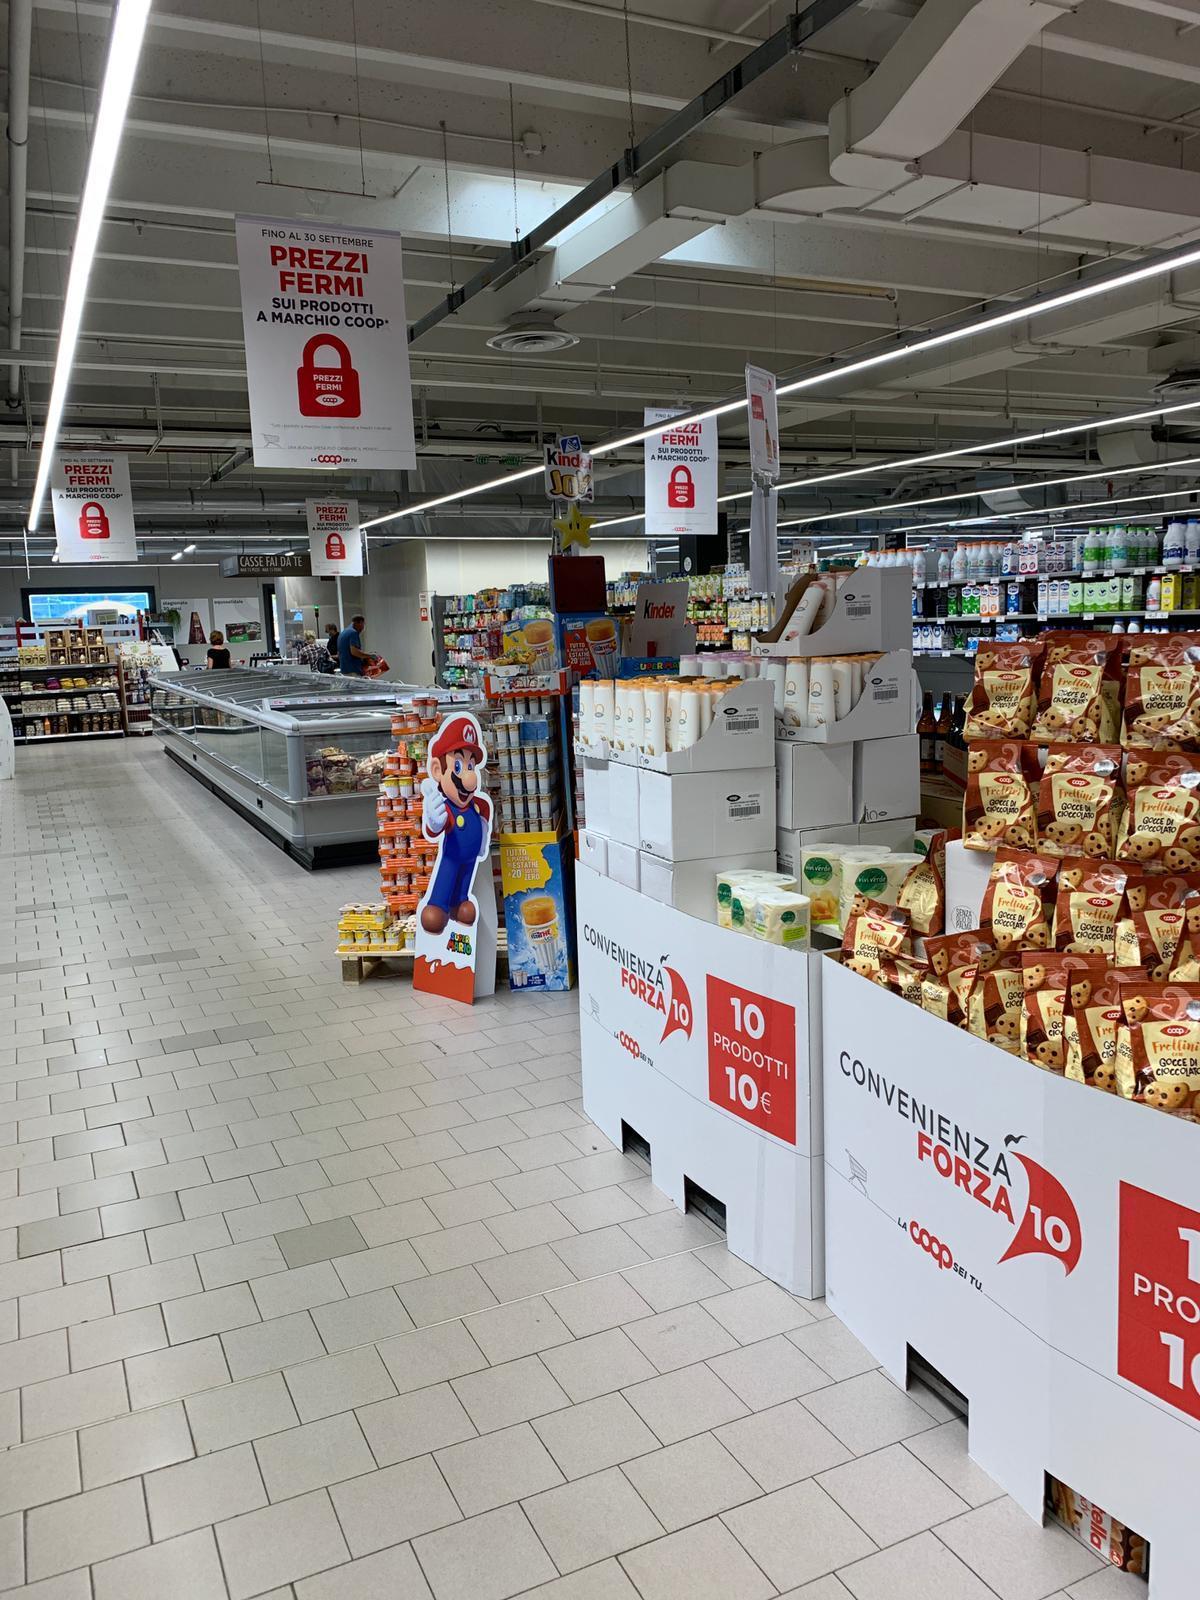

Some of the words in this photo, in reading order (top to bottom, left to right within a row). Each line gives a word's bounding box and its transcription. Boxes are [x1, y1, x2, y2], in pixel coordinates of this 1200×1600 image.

[261, 228, 286, 240] FINO
[288, 231, 302, 241] AL
[304, 232, 317, 242] 30
[318, 234, 374, 248] SETTEMBRE
[269, 245, 369, 274] PREZZI
[279, 271, 364, 297] FERMI
[271, 297, 296, 310] SUI
[300, 299, 373, 315] PRODOTTI
[256, 310, 267, 322] A
[271, 312, 341, 327] MARCHIO
[313, 374, 343, 382] PREZZI
[315, 383, 342, 391] FERMI
[661, 434, 699, 446] FERMI
[317, 454, 342, 465] coop
[64, 465, 112, 475] PREZZI
[69, 476, 111, 485] FERMI
[316, 506, 348, 514] PREZZI
[240, 556, 264, 567] CASSE
[266, 556, 278, 567] FAI
[280, 556, 292, 567] DA
[293, 556, 303, 567] TE
[643, 599, 675, 619] Kinder
[1149, 694, 1174, 702] GOCCE
[1145, 702, 1186, 710] CIOCCOLATO
[464, 726, 475, 742] M
[985, 806, 1019, 815] CIOCCOLATO
[1061, 802, 1084, 811] GOCCE
[1085, 804, 1092, 812] DI
[1056, 810, 1095, 820] CIOCCOLATO
[1142, 816, 1165, 825] GOCCE
[1137, 825, 1177, 834] CIOCCOLATO
[997, 897, 1031, 910] Frettini
[997, 911, 1017, 920] GOCCE
[994, 919, 1026, 930] CIOCCOLATO
[1080, 923, 1105, 932] GOCCE
[1105, 925, 1114, 933] DI
[450, 931, 470, 944] SUPER
[447, 939, 473, 955] MARIO
[583, 924, 665, 990] CONVENIENZA
[620, 967, 667, 1016] FORZA
[672, 998, 690, 1027] 10
[730, 997, 766, 1040] 10
[619, 1030, 640, 1060] coop
[1152, 1038, 1200, 1054] Frettini
[713, 1031, 788, 1080] PRODOTTI
[1159, 1058, 1188, 1067] GOCCE
[1189, 1058, 1198, 1067] DI
[839, 1050, 1012, 1187] CONVENIENZA
[917, 1130, 1016, 1226] FORZA
[1029, 1205, 1072, 1253] 10
[897, 1217, 908, 1232] LA
[909, 1220, 953, 1270] coop
[952, 1262, 968, 1279] SEI
